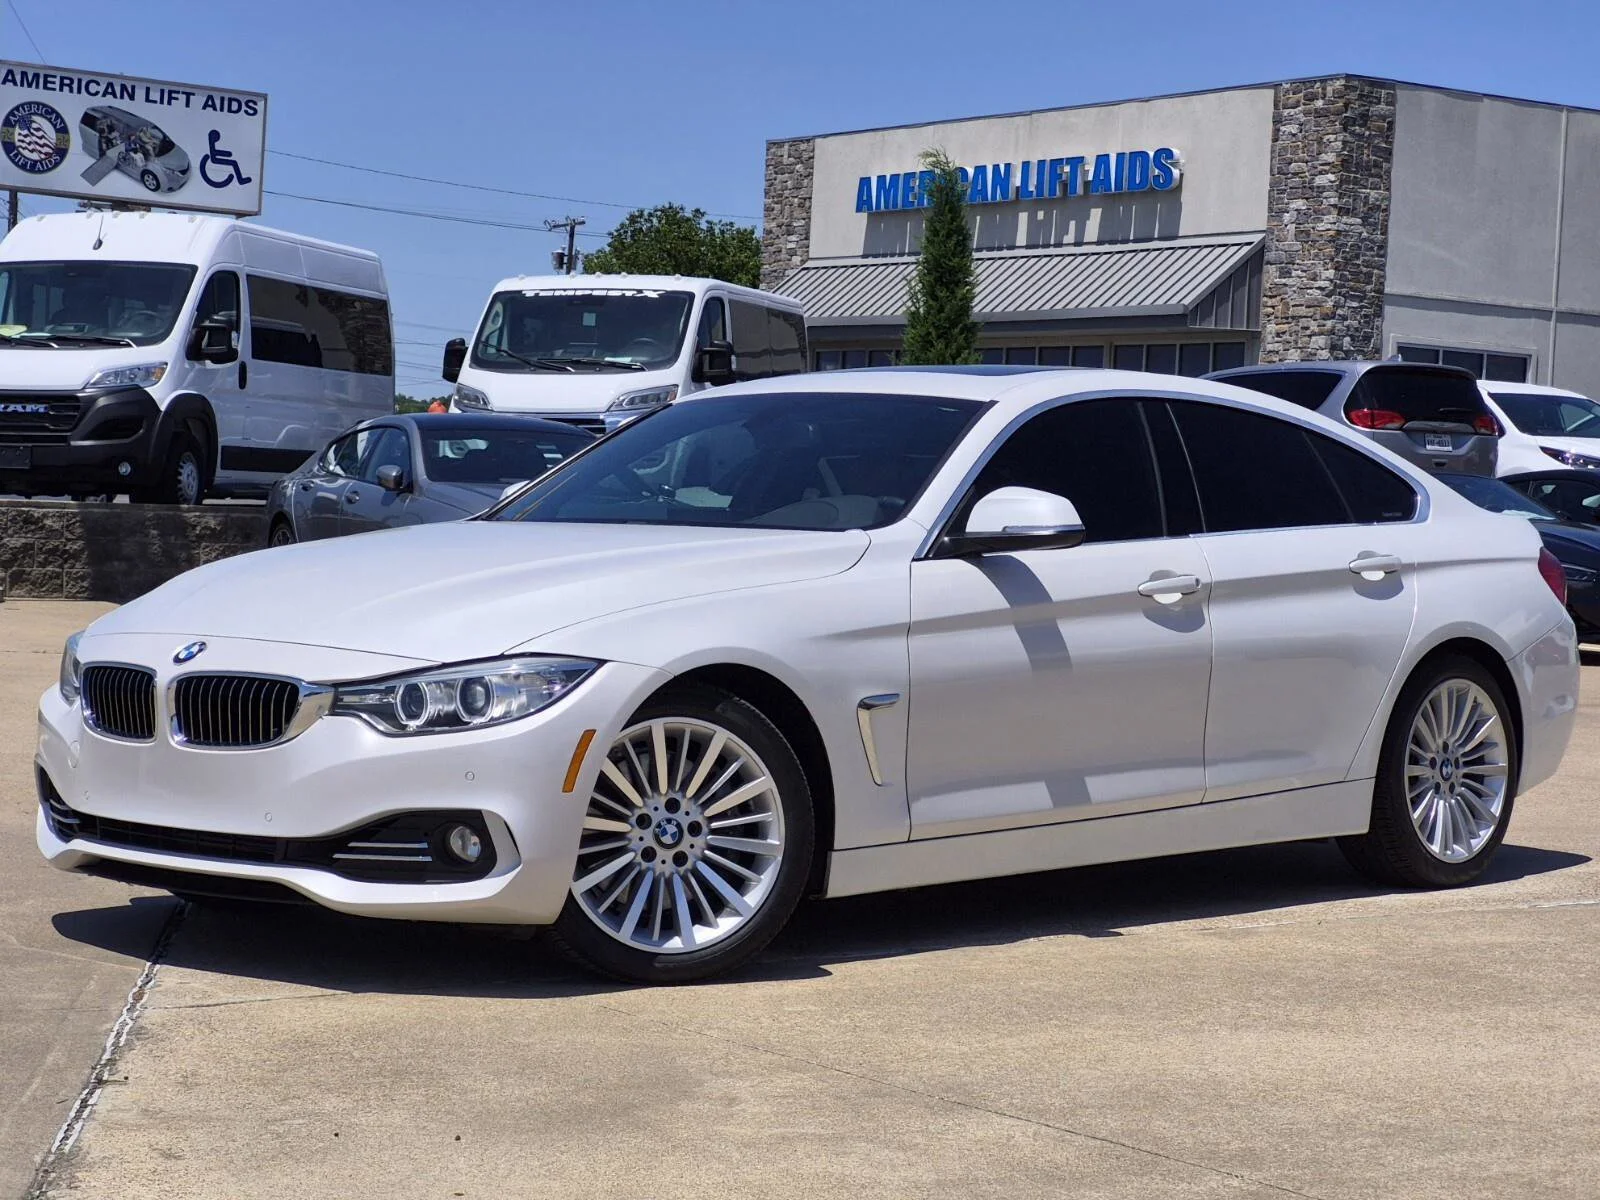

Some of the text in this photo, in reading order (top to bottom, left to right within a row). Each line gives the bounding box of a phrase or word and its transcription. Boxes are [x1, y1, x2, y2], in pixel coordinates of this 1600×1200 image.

[1, 68, 258, 117] AMERICAN LIFT AIDS
[9, 104, 65, 129] AMERICAN
[9, 150, 61, 171] LIFT AIDS
[855, 147, 1176, 213] AMERCAN LIFT AIDS
